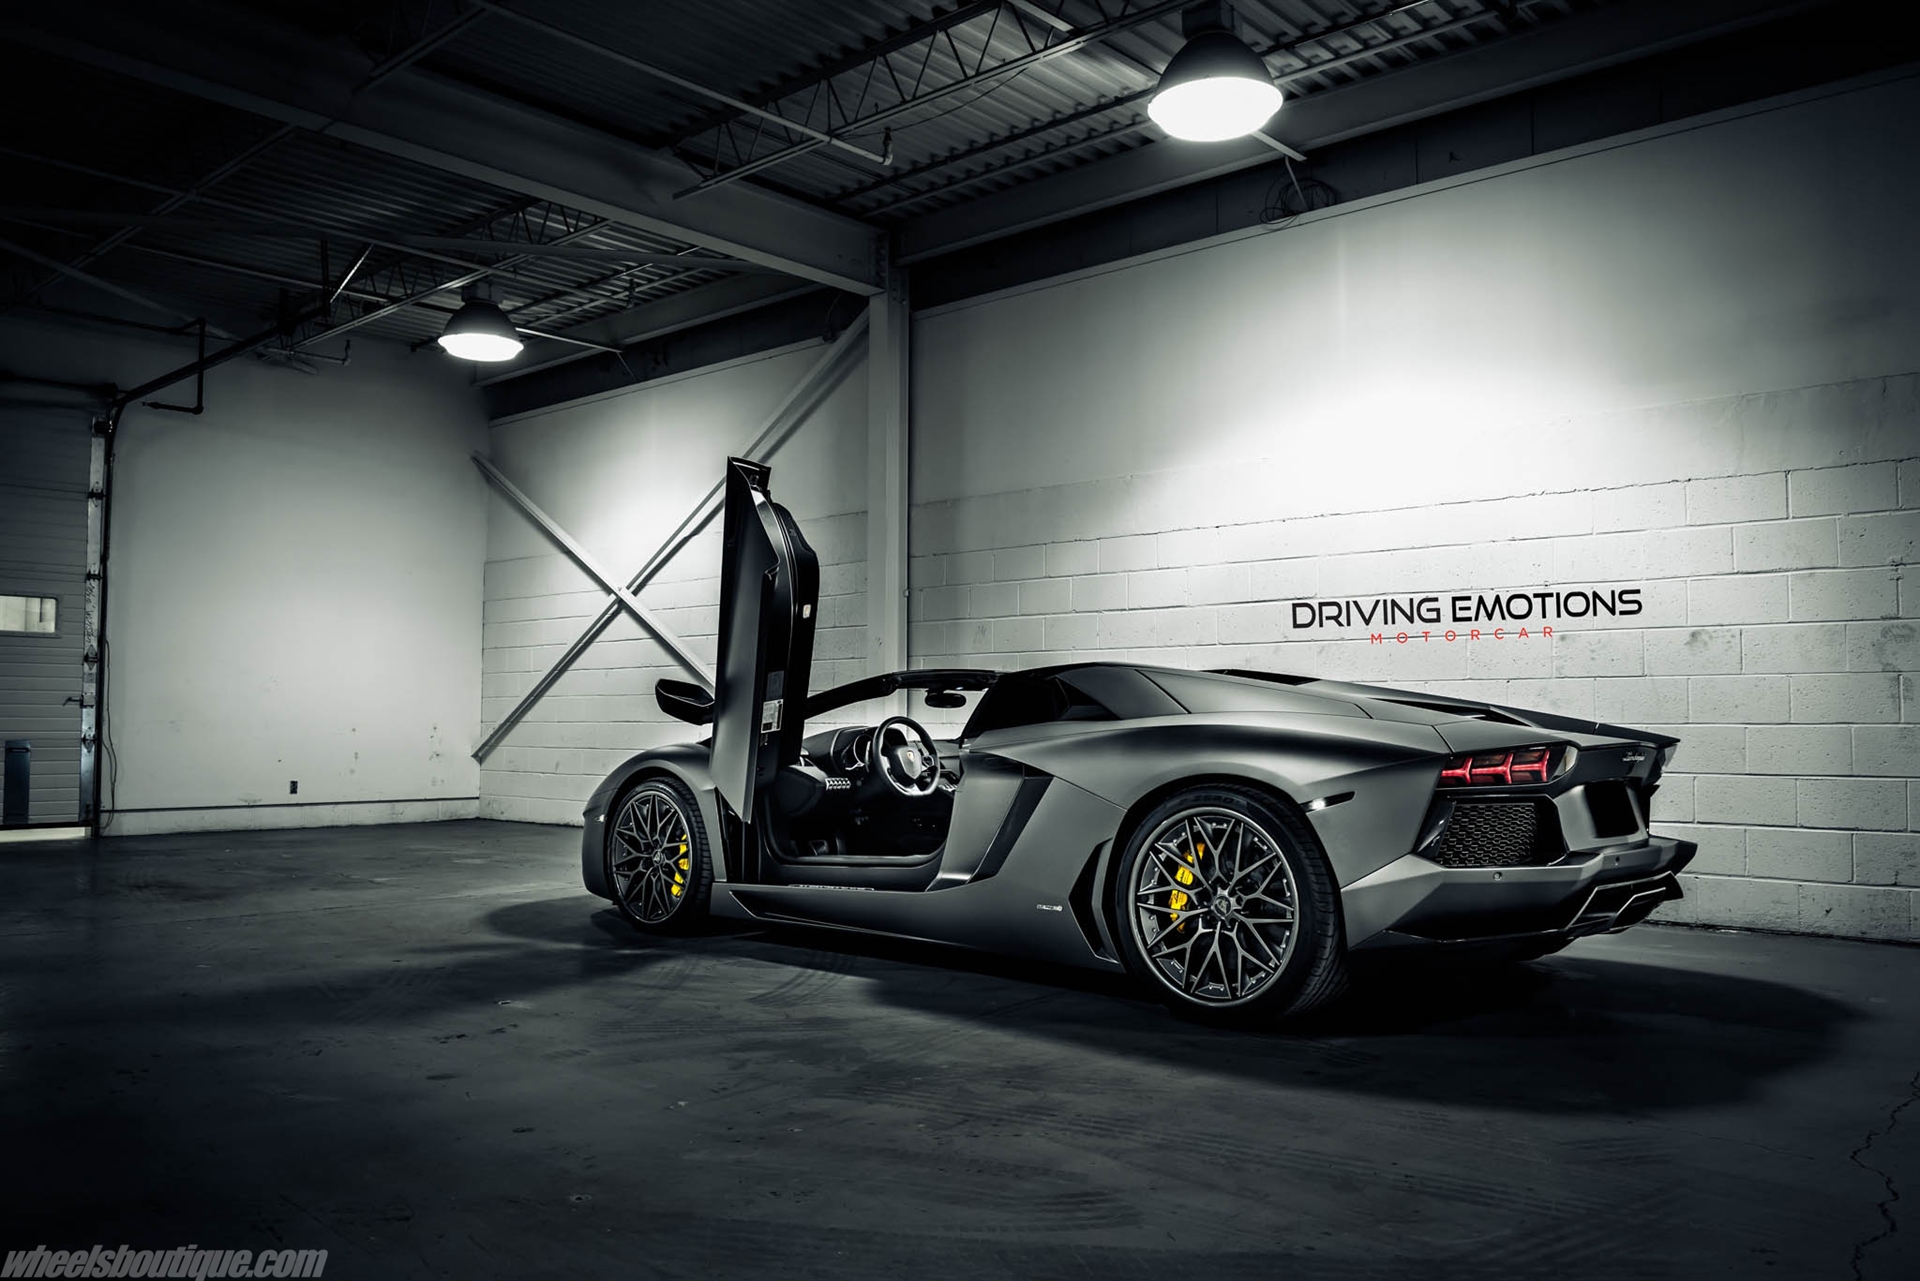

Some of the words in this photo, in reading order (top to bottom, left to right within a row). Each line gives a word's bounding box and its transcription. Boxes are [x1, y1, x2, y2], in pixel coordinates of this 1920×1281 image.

[1292, 597, 1441, 629] DRIVING
[1451, 589, 1643, 623] EMOTIONS
[1370, 626, 1553, 645] MOTORCAR
